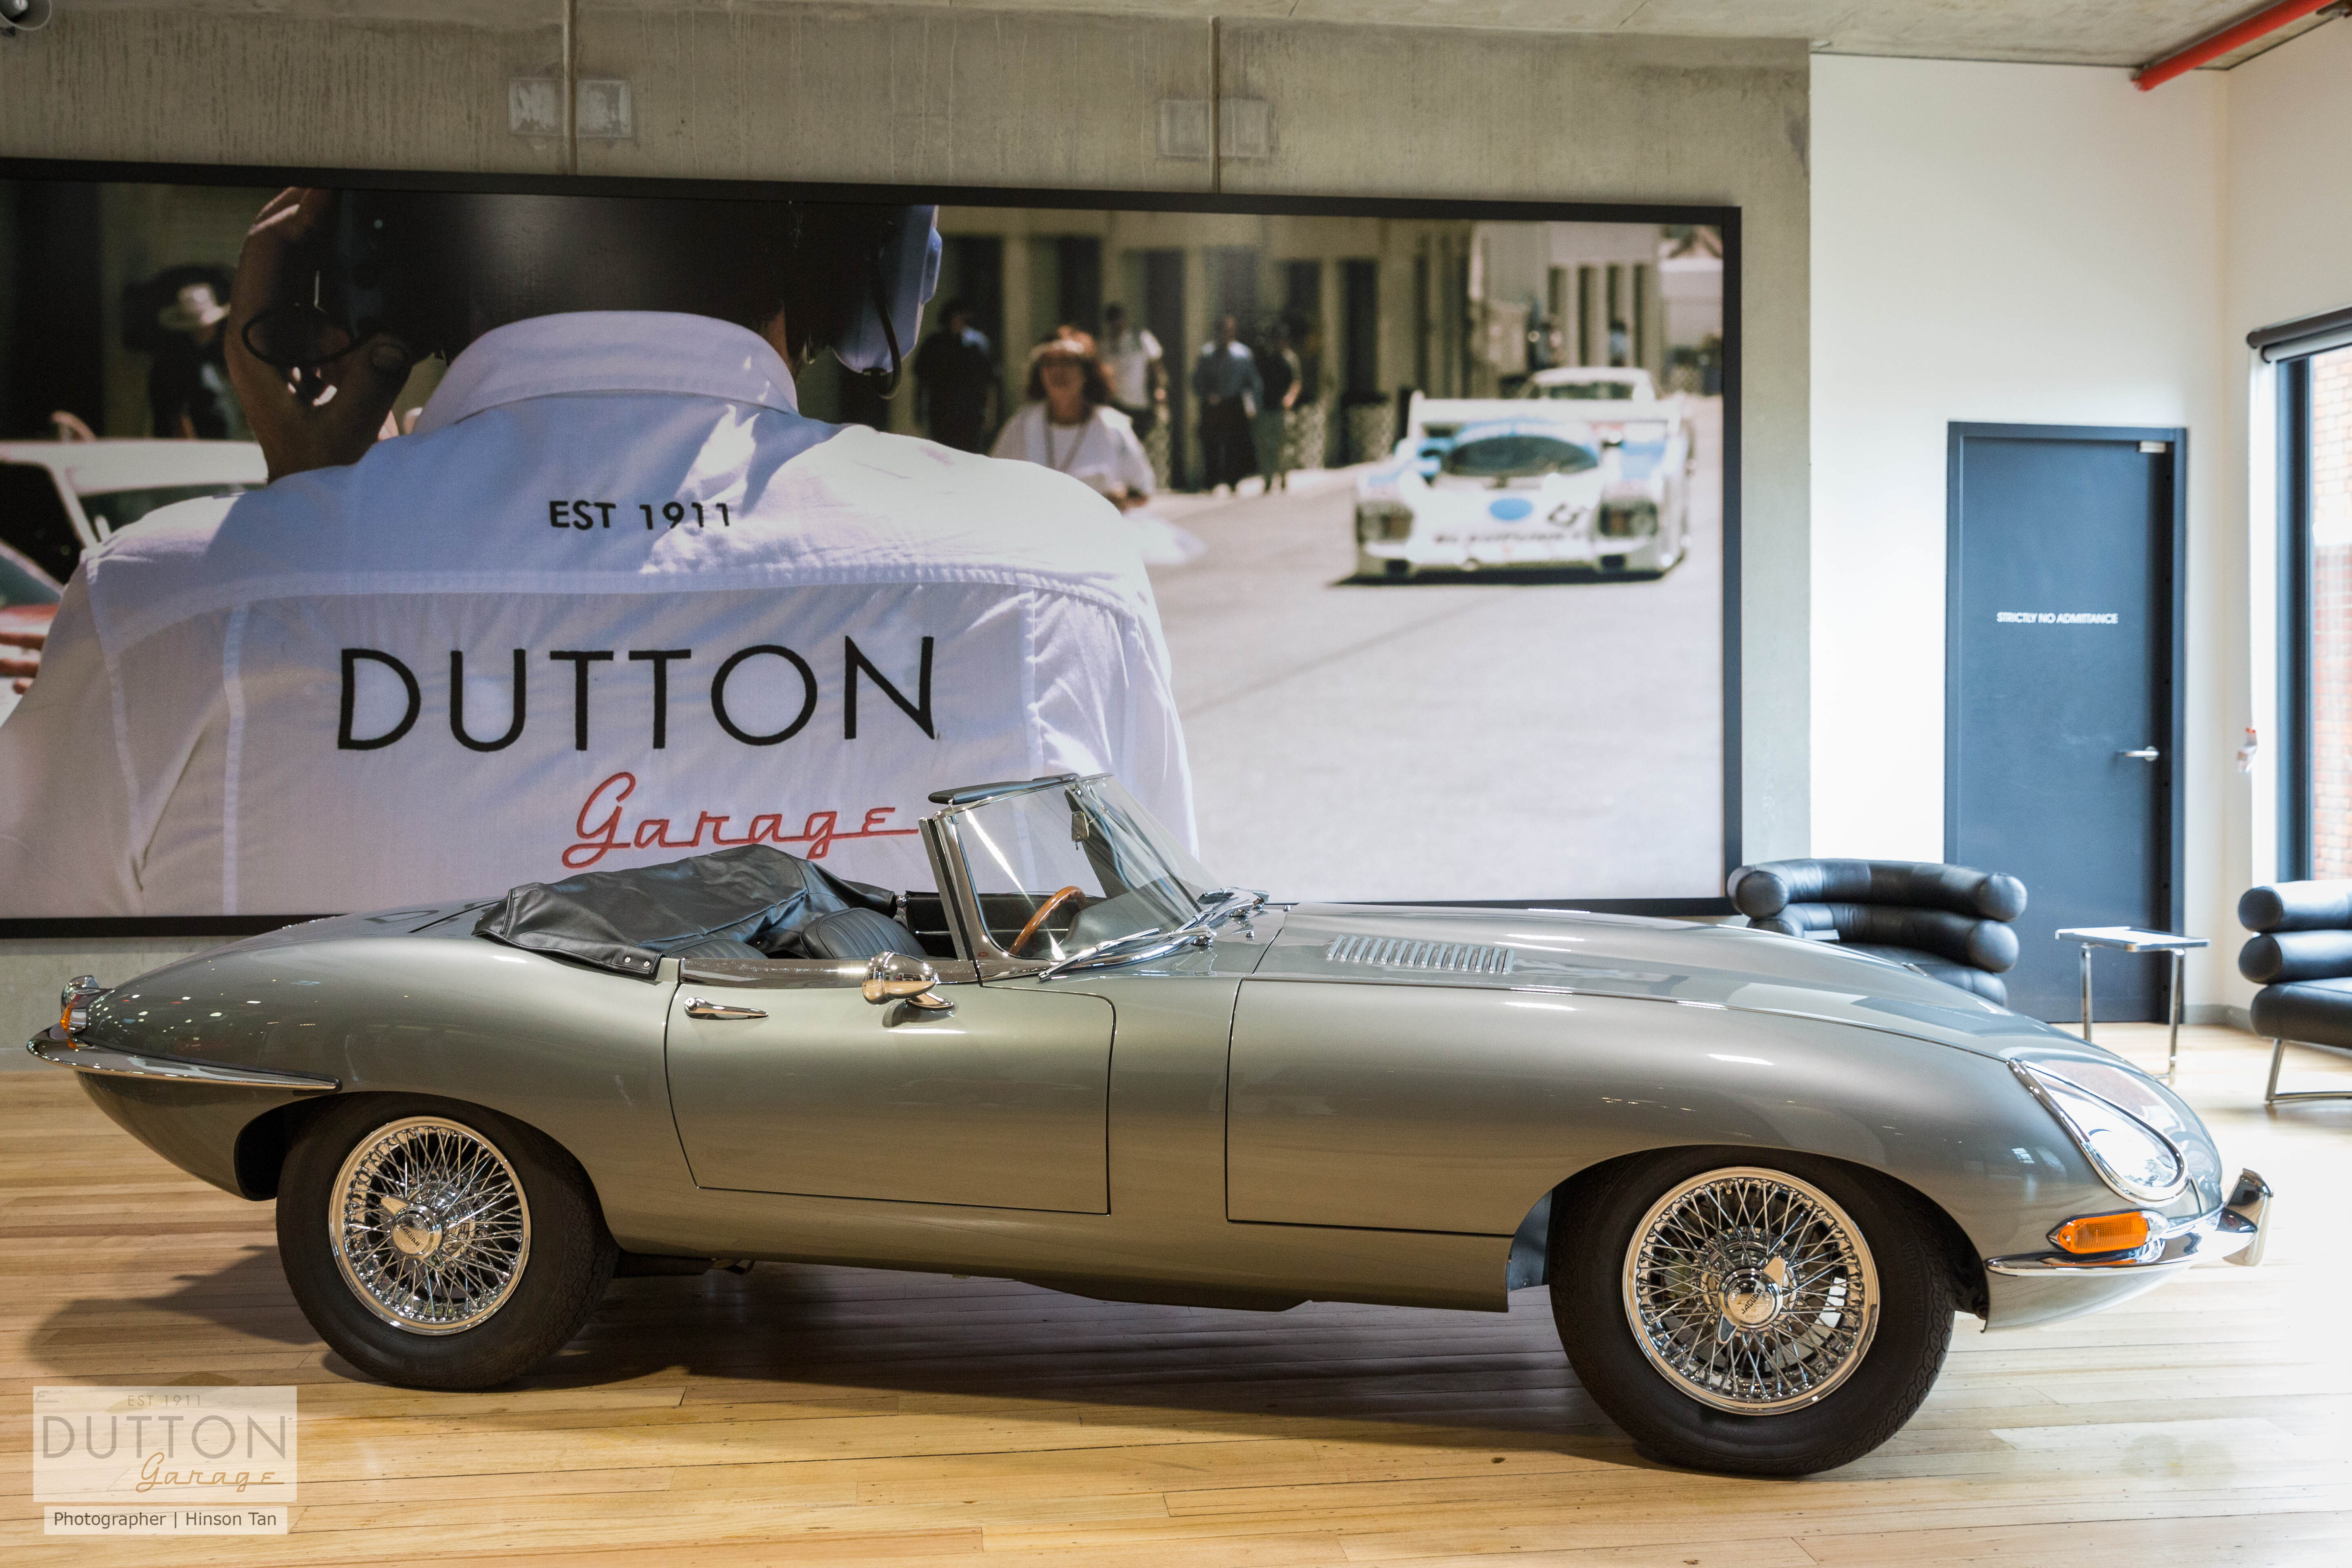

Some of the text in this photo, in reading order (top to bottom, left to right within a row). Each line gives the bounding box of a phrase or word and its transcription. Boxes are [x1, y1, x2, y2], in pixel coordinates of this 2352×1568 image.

[550, 500, 731, 531] EST 1911
[1997, 612, 2118, 624] STRICTLY NO ADMITTANCE
[338, 635, 935, 753] DUTTON
[562, 772, 920, 870] Garage
[1741, 1288, 1763, 1314] JAGUAR
